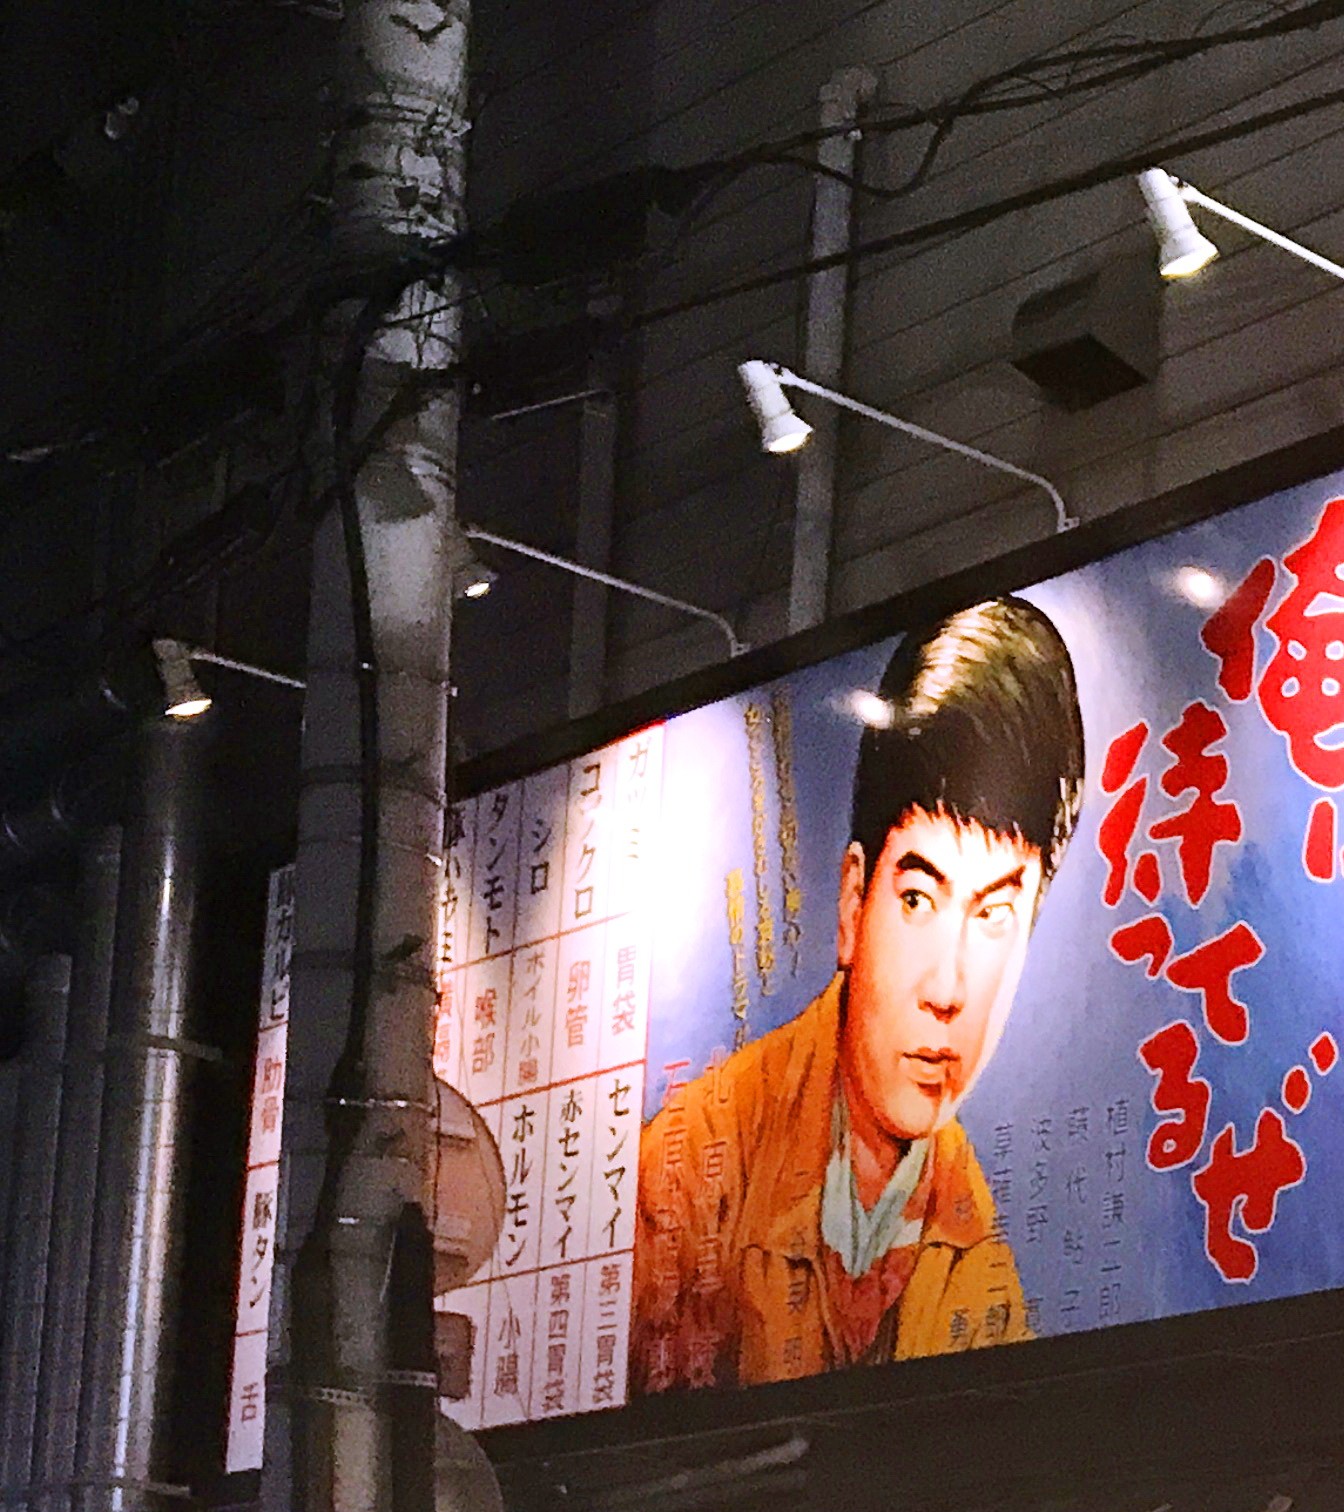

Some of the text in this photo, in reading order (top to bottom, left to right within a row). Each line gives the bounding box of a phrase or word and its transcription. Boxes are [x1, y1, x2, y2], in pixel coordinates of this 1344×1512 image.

[481, 795, 508, 956] タンモト
[531, 817, 551, 895] シロ
[1098, 702, 1337, 1283] 待ってるぜ
[504, 1104, 535, 1267] ホルモン
[555, 1089, 584, 1258] 赤センマイ
[602, 1079, 632, 1249] センマイ
